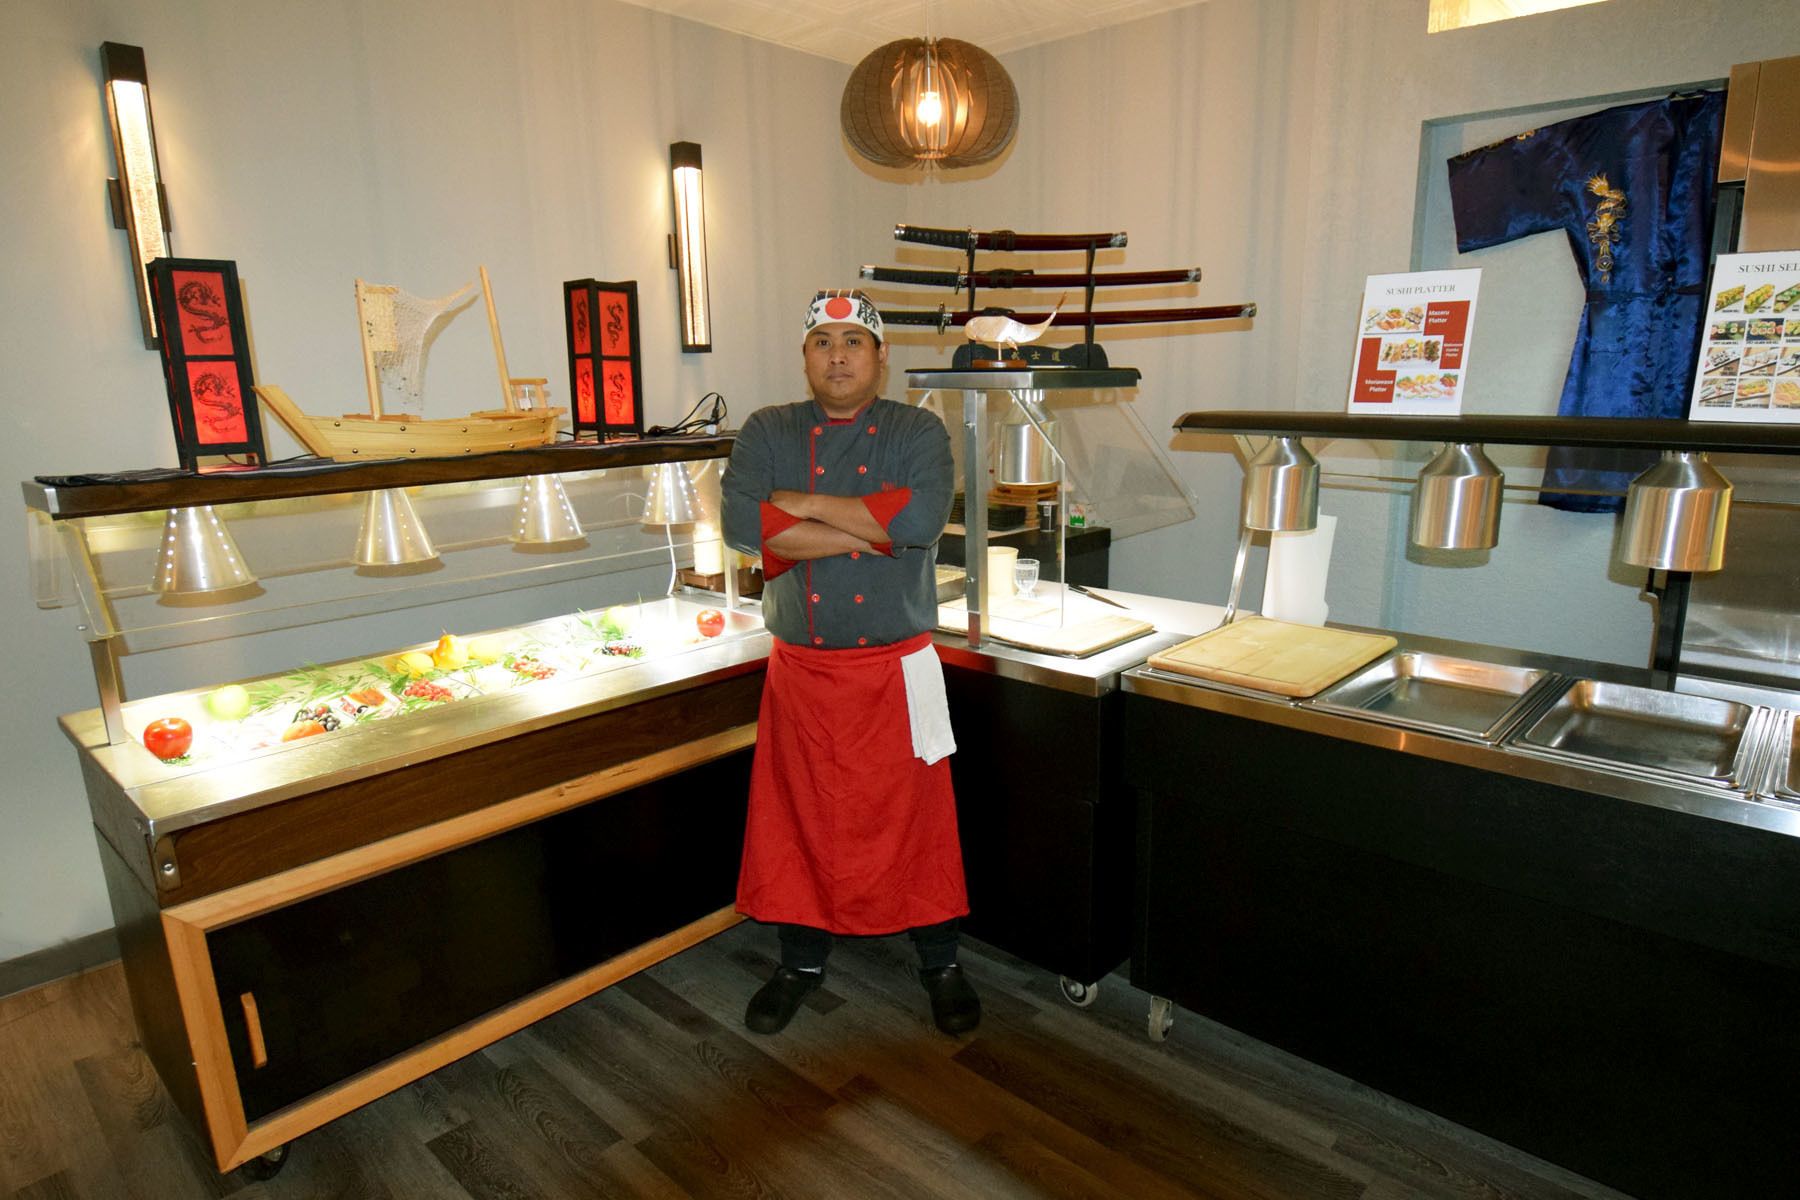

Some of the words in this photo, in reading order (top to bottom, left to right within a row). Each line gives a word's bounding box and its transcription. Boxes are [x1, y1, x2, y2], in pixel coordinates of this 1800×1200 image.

[1738, 264, 1775, 273] SUSHI
[1385, 287, 1413, 295] SUSHI
[1414, 284, 1456, 294] PLATTER
